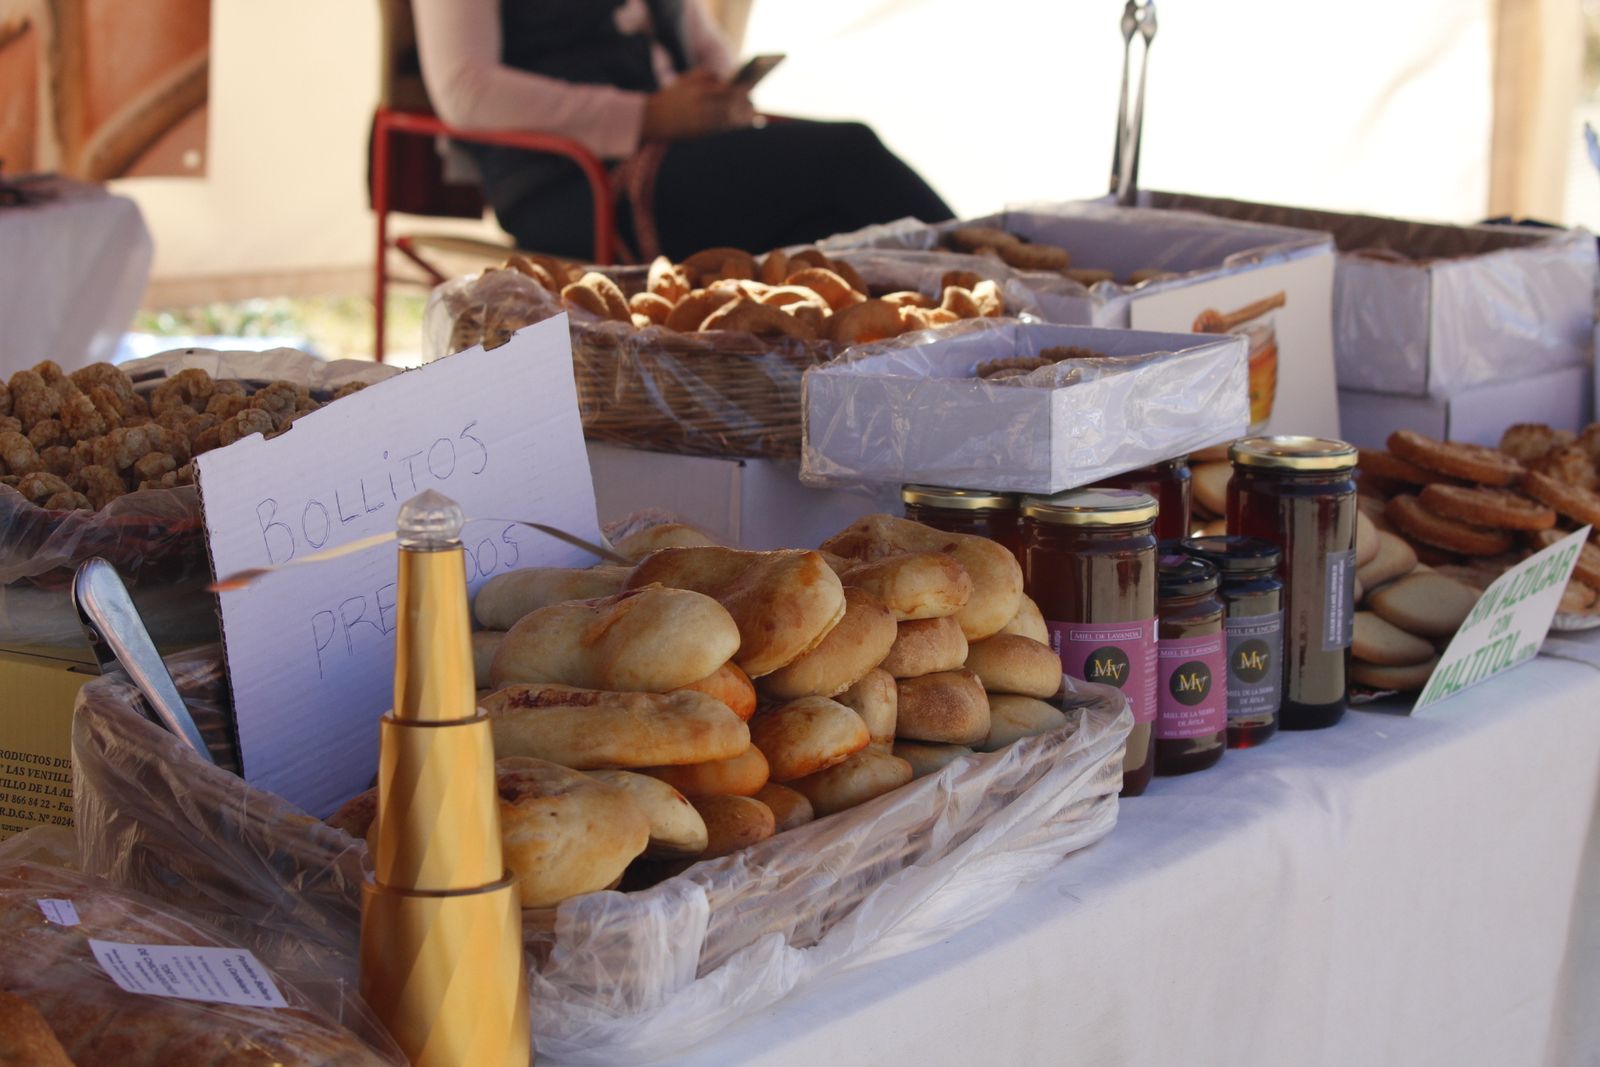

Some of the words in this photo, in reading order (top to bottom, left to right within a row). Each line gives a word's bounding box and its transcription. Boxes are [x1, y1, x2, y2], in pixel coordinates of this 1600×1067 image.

[311, 523, 520, 680] PREDOS
[1421, 631, 1521, 706] MALTITOL
[27, 768, 73, 783] VENTILL
[29, 782, 42, 793] DE
[45, 785, 58, 796] LA
[11, 794, 26, 805] 866
[28, 797, 38, 807] 84
[40, 799, 50, 809] 22
